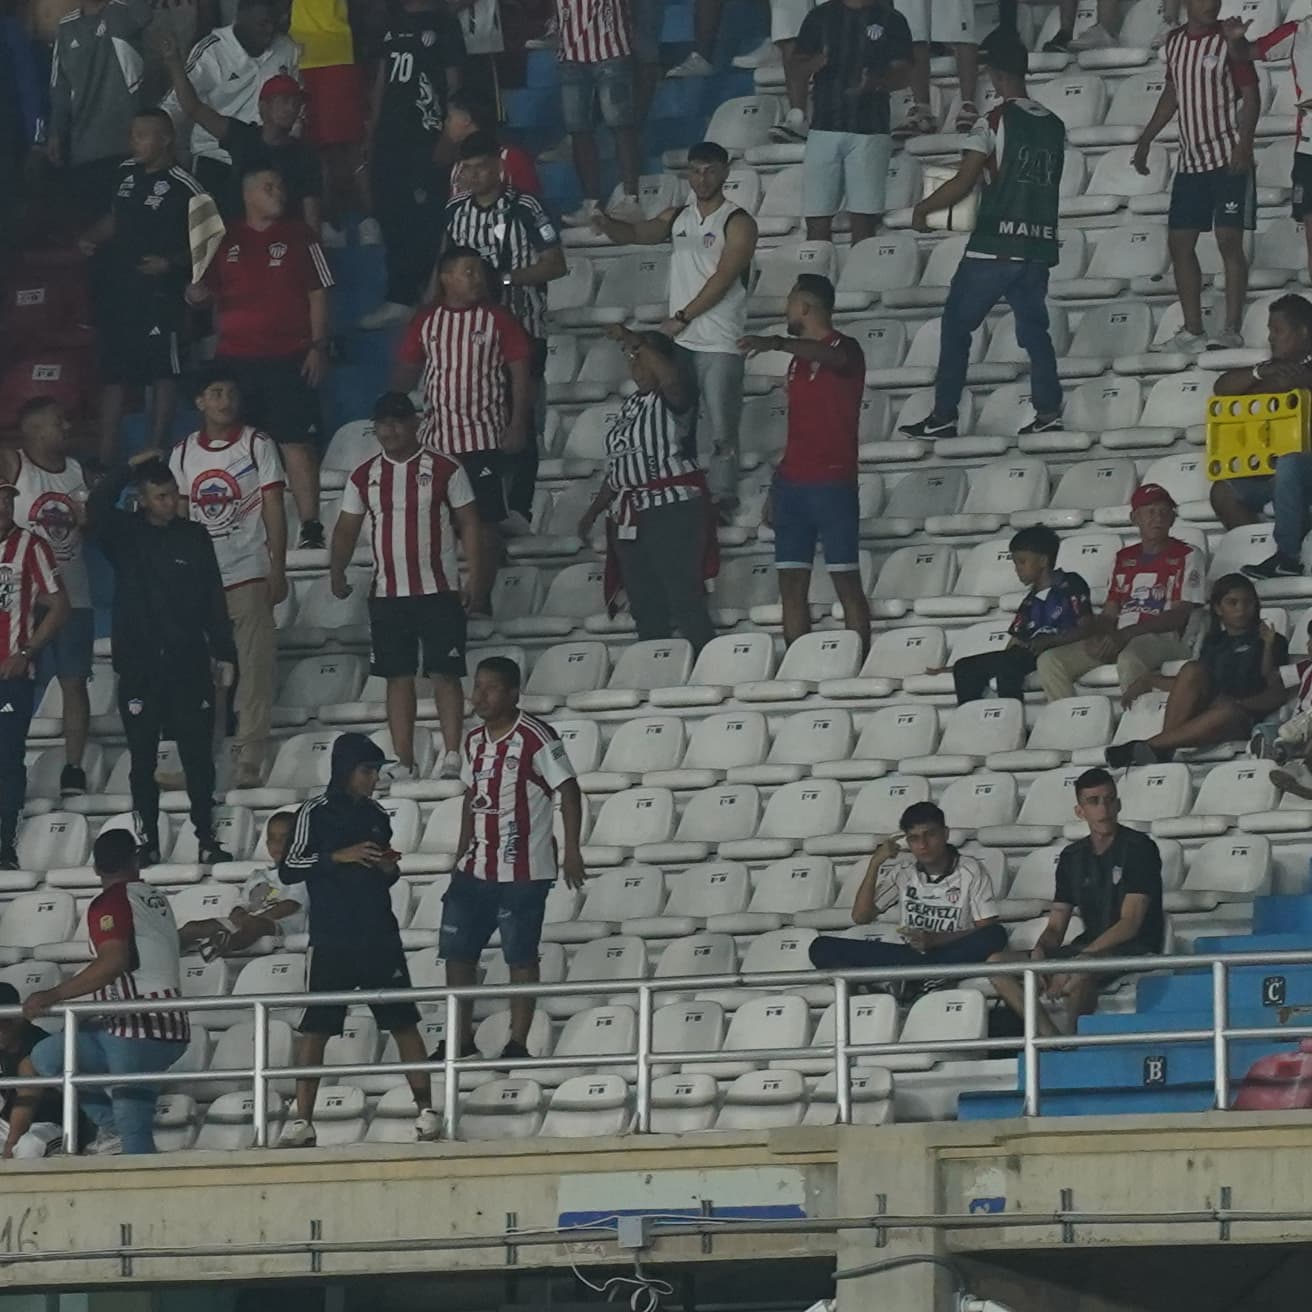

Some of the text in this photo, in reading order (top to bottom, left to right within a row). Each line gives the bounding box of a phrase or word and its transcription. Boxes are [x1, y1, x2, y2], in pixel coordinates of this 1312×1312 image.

[389, 51, 414, 84] 70
[905, 901, 959, 921] CERVEZA
[908, 915, 956, 932] AGUILA
[1267, 981, 1282, 1002] C
[1149, 1061, 1163, 1081] B
